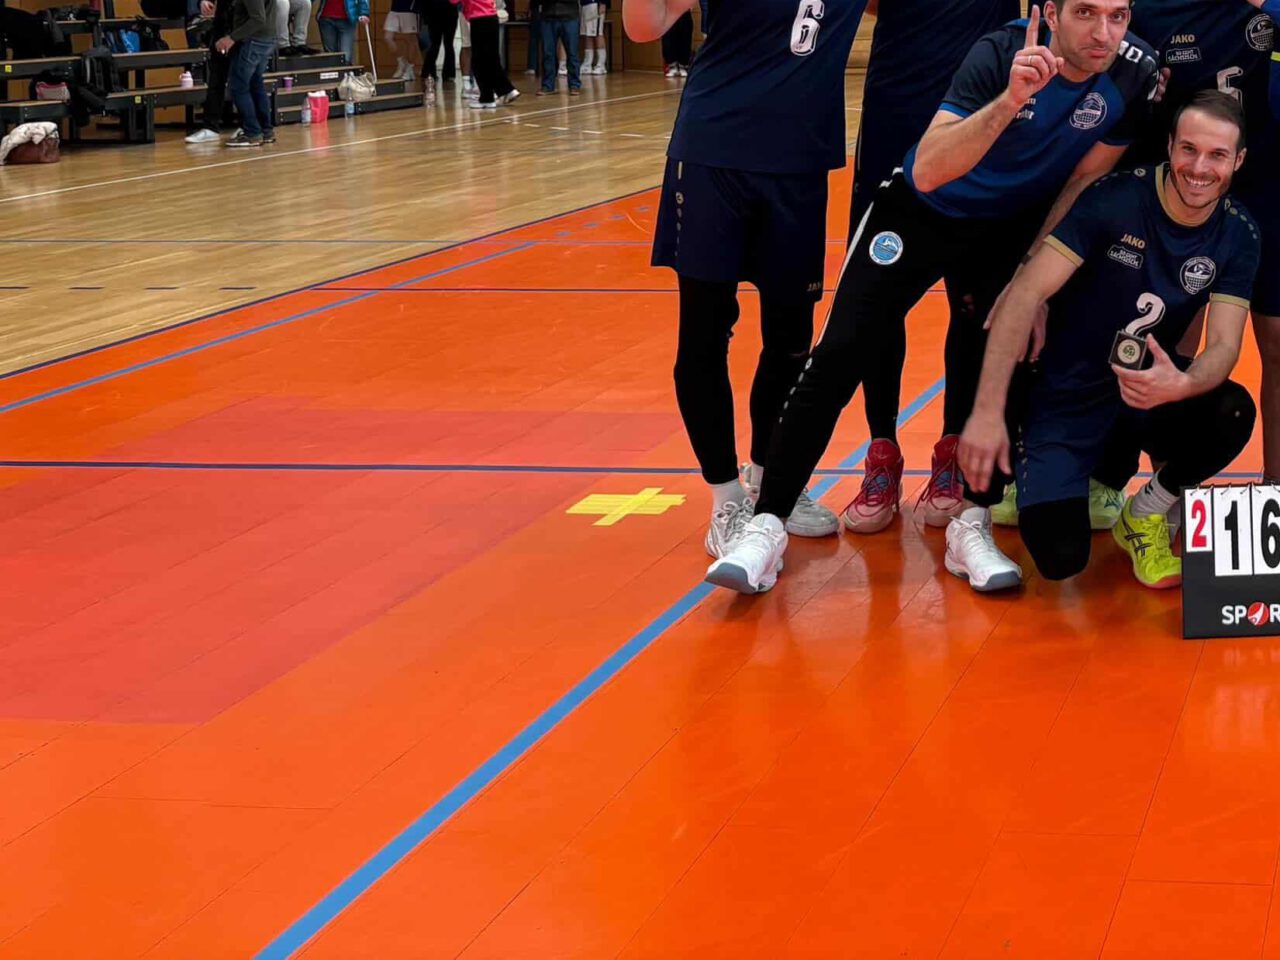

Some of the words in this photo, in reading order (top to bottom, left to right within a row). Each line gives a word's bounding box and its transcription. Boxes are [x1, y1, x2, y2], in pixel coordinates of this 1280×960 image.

[1170, 34, 1195, 44] JAKO
[1121, 233, 1146, 249] JAKO
[1125, 292, 1166, 337] 2
[1191, 499, 1207, 548] 2
